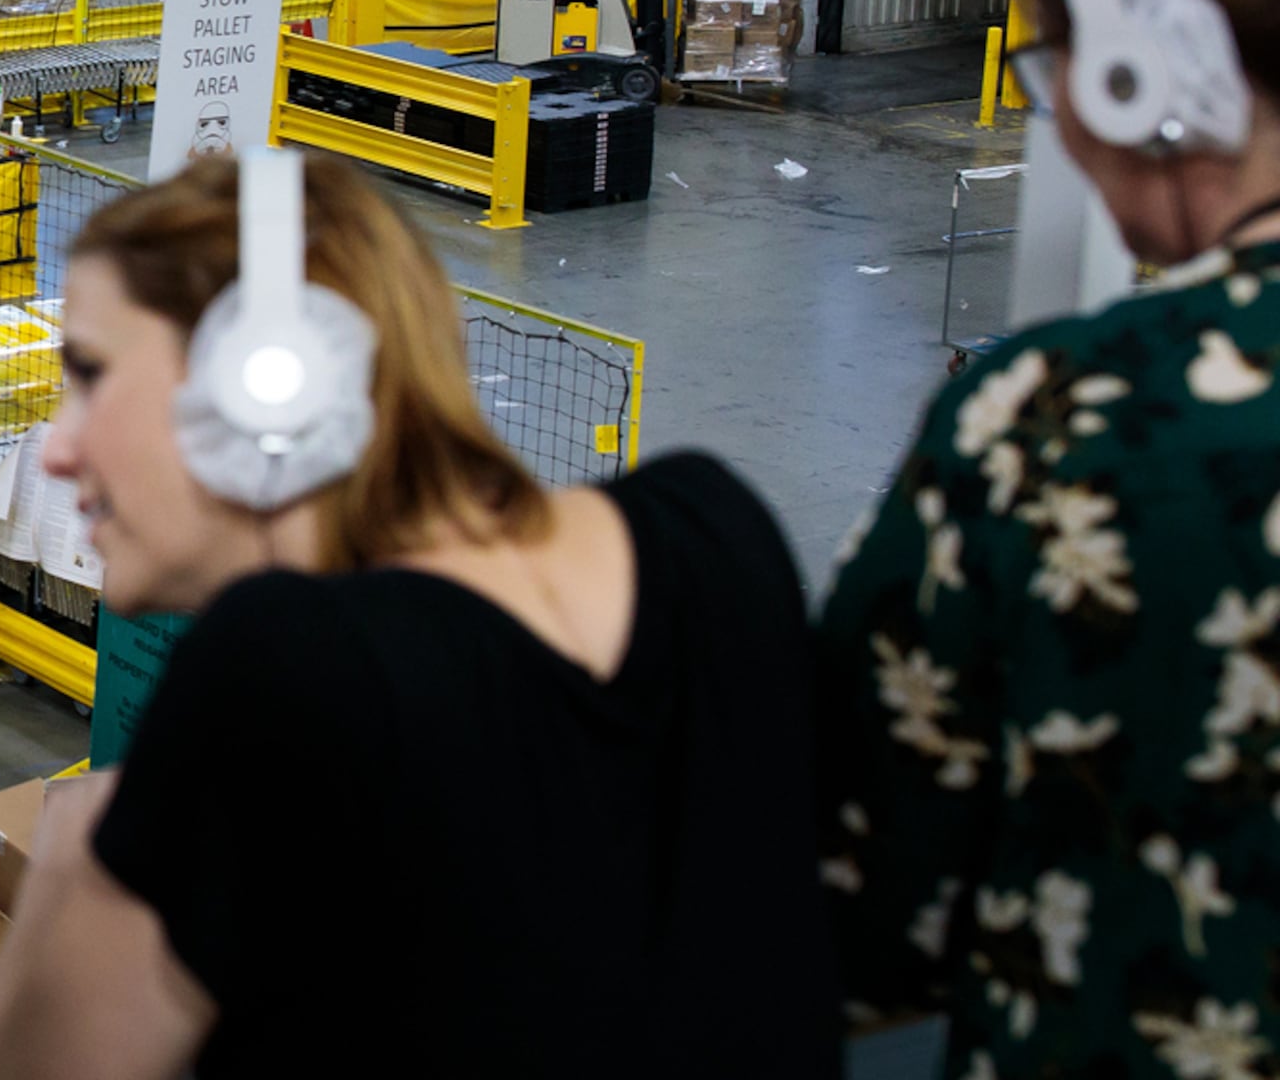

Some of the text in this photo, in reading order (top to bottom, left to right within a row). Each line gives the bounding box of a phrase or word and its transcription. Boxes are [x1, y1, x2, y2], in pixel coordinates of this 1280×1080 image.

[193, 15, 253, 38] PALLET
[182, 44, 256, 69] STAGING
[194, 75, 239, 97] AREA
